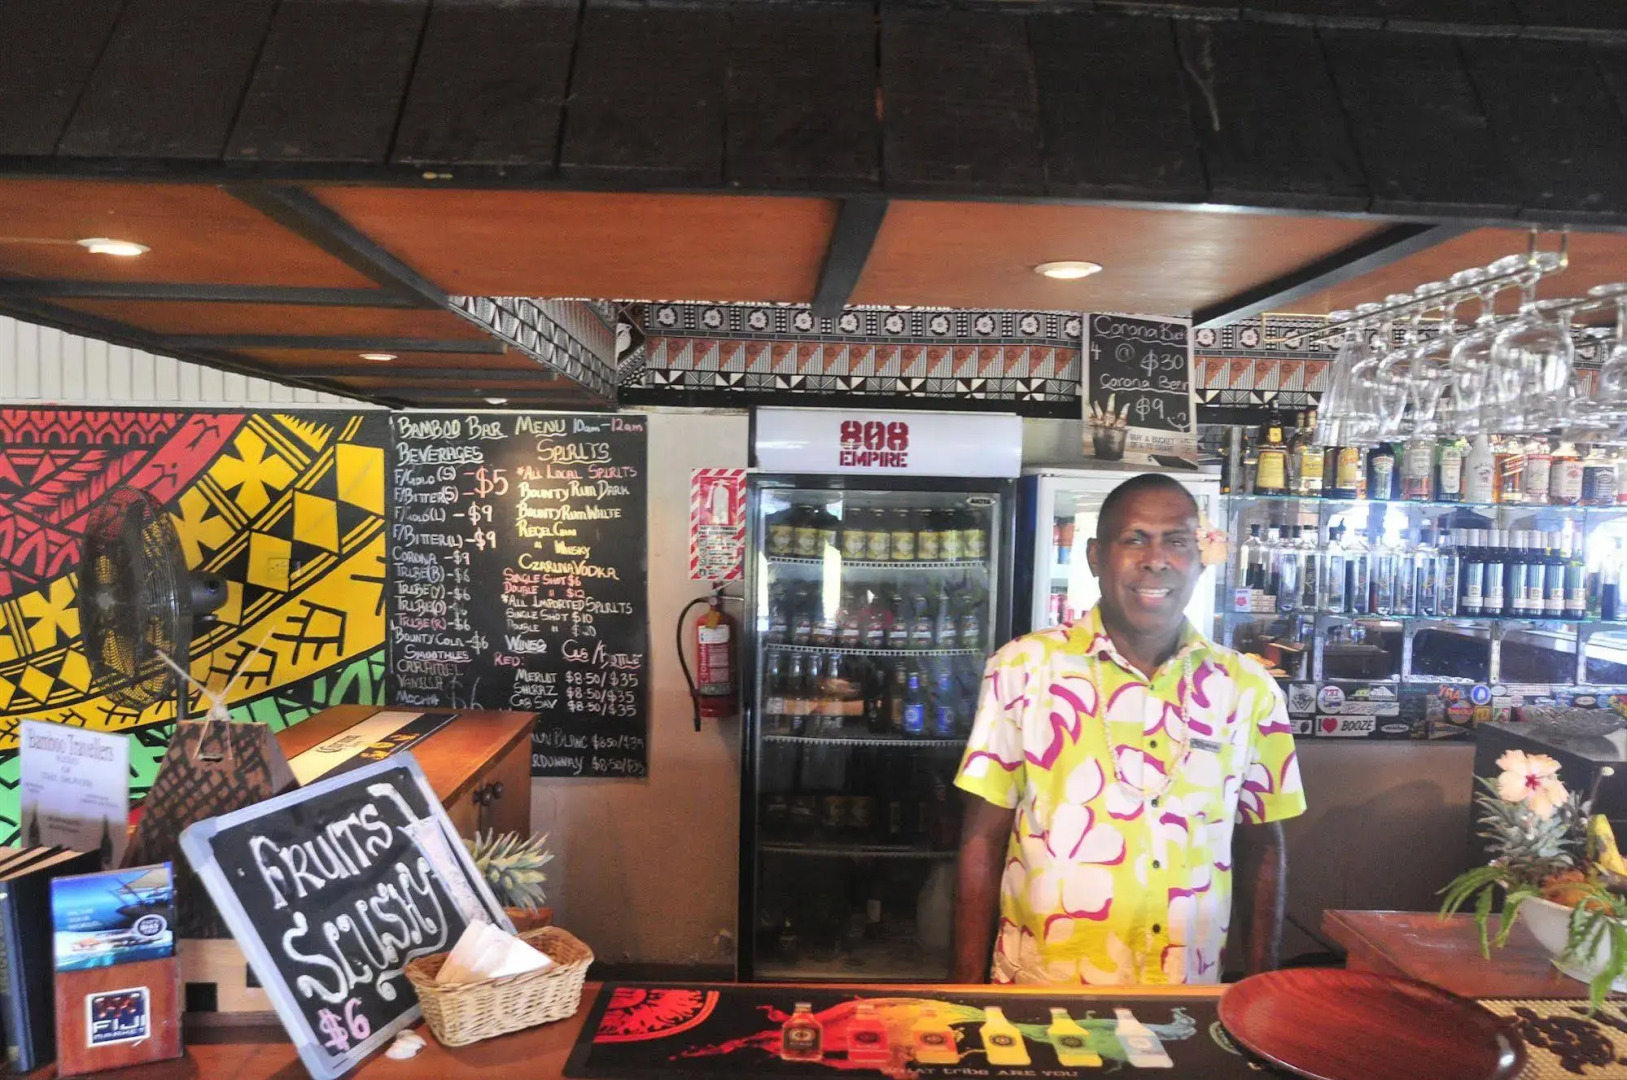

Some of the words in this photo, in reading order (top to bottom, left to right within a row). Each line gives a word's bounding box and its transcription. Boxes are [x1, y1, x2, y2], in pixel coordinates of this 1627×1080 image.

[1093, 315, 1157, 337] Corona
[1140, 350, 1184, 377] $30
[1100, 373, 1150, 388] Corona
[1158, 375, 1189, 391] Beer
[1136, 396, 1164, 421] $9
[397, 416, 461, 439] BAMBOO
[465, 415, 502, 439] BAR
[514, 416, 566, 435] MENU
[841, 420, 909, 451] 808
[396, 442, 484, 465] BEVERAGES
[536, 438, 610, 462] SPIRITS
[839, 451, 909, 467] EMPIRE
[546, 464, 583, 480] LOCAL
[588, 464, 638, 478] SPIRITS
[517, 481, 569, 502] BOUNTY
[567, 480, 597, 496] RUM
[597, 480, 630, 500] DARK
[516, 500, 561, 520] BOUNTY
[560, 504, 587, 520] RUM
[586, 504, 622, 520] WHITE
[392, 546, 438, 565] CORONA
[572, 560, 620, 580] VODKA
[502, 581, 540, 596] DOUBLE
[567, 573, 582, 587] $6
[532, 595, 585, 611] IMPORTED
[585, 597, 633, 615] SPIRITS
[506, 607, 539, 619] SINGLE
[540, 609, 569, 621] SHOT
[571, 611, 594, 624] $10
[395, 626, 434, 644] BOUNTY
[504, 634, 548, 651] WINES
[404, 643, 470, 660] SMOOTHIES
[396, 659, 464, 677] CARAMEL
[396, 674, 443, 691] VANILLA
[513, 682, 558, 696] SHIRAZ
[534, 696, 558, 709] SAV
[1317, 716, 1323, 732] I
[1340, 720, 1374, 732] BOOZE
[249, 803, 394, 910] FRUITS
[282, 856, 449, 1004] SLUSHY
[93, 1014, 146, 1034] FIJI
[317, 996, 372, 1052] $6
